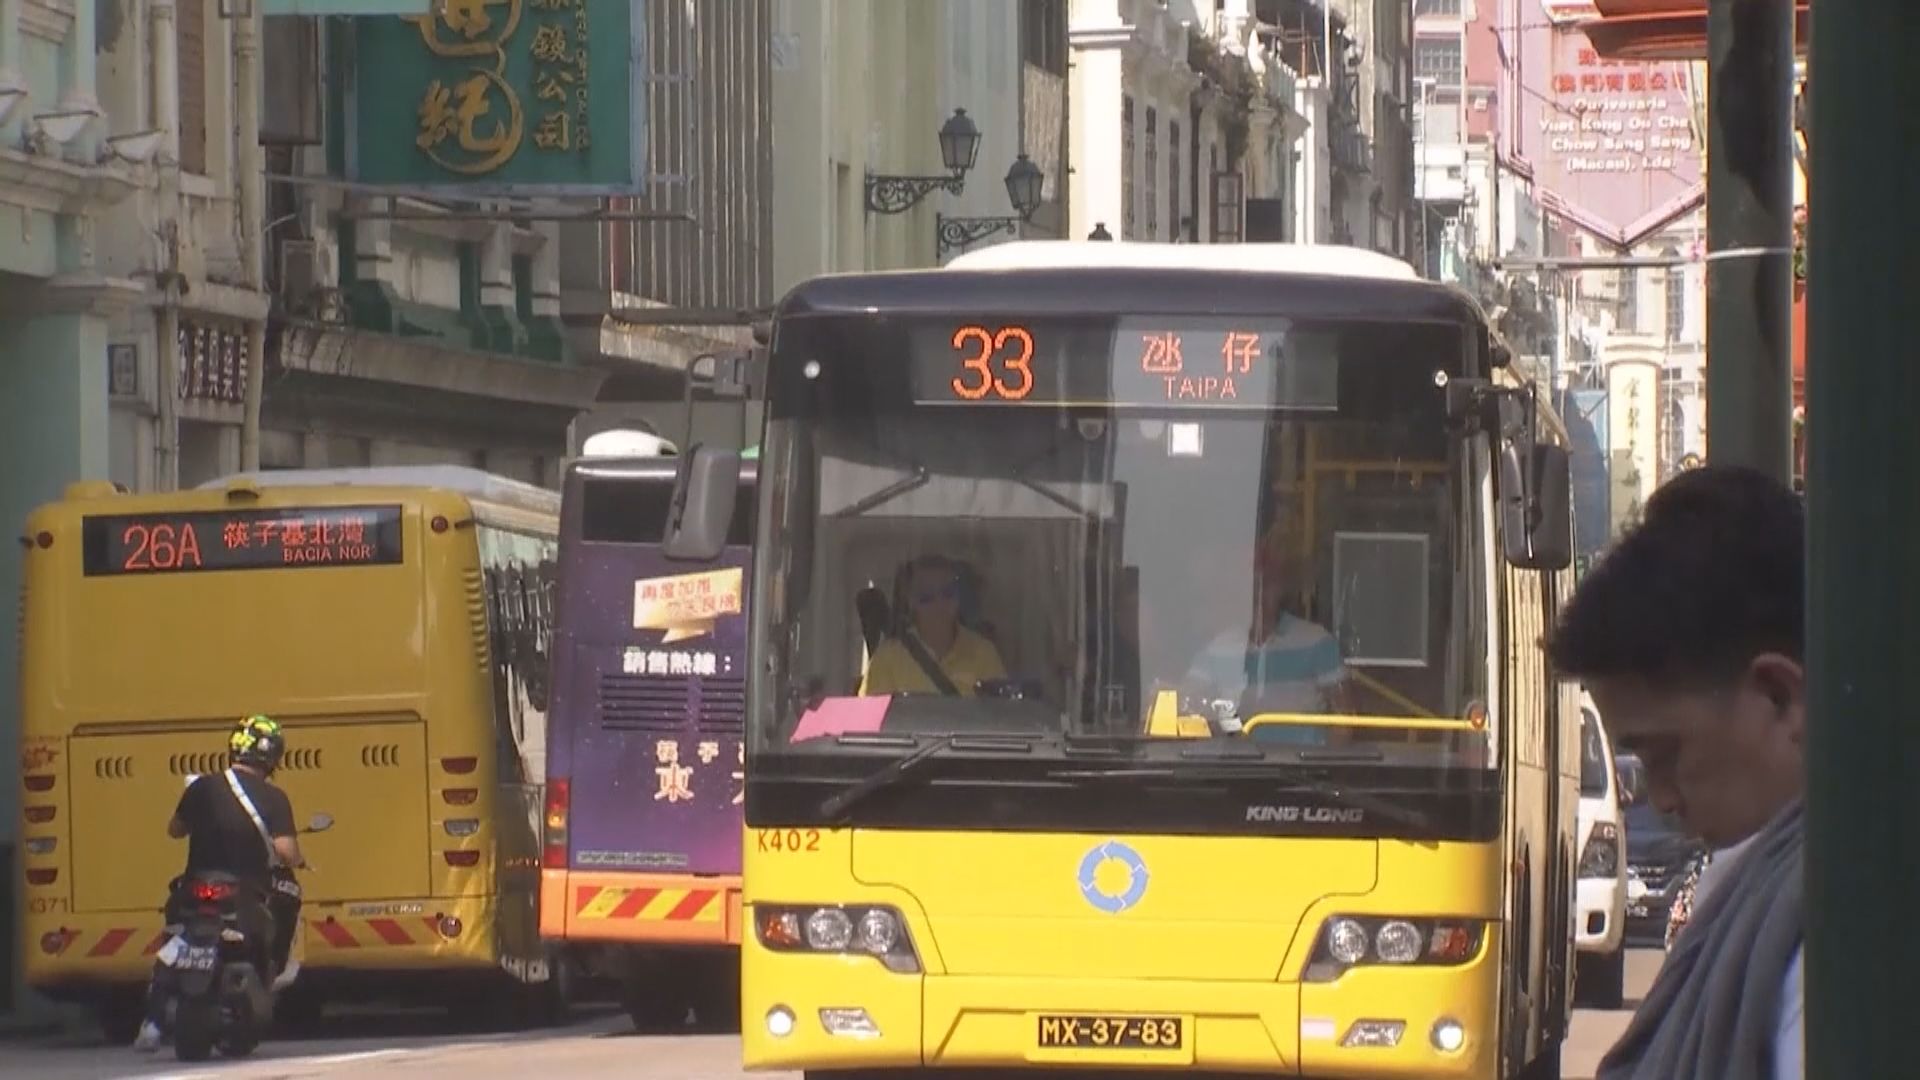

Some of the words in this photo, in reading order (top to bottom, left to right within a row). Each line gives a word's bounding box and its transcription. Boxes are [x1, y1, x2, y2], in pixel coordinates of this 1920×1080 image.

[1551, 137, 1598, 151] Chow
[1603, 137, 1645, 153] Sang
[1650, 134, 1692, 151] Sang
[951, 325, 1036, 401] 33
[1162, 376, 1237, 399] TAIPA
[123, 523, 202, 571] 26A
[757, 826, 820, 852] K402
[1041, 1018, 1178, 1045] MX-37-83
